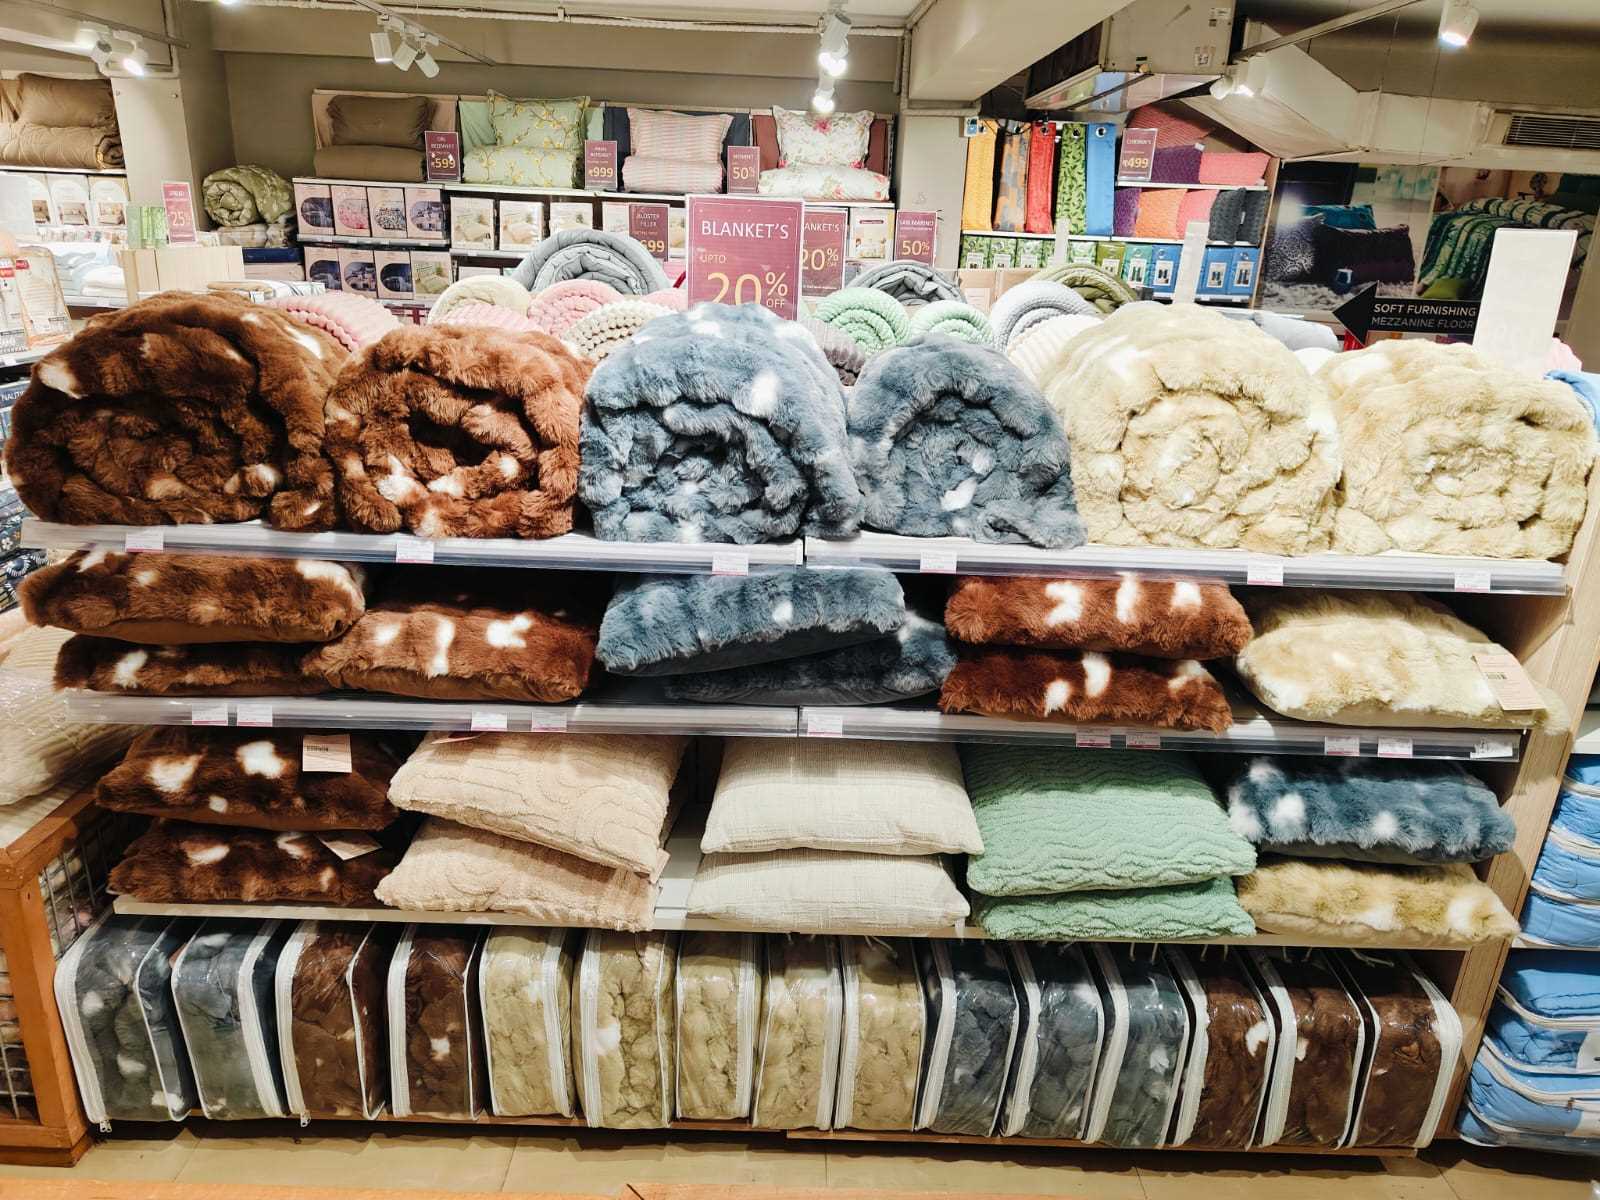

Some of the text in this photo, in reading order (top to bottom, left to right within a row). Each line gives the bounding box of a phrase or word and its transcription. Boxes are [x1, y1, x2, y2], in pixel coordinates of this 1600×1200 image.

[701, 220, 789, 240] BLANKET'S
[804, 223, 840, 232] ANKET'S
[700, 254, 727, 264] UPTO
[766, 298, 786, 308] OFF
[1373, 303, 1477, 316] SOFT FURNISHING
[1371, 316, 1474, 329] MEZZANINE FLOOR
